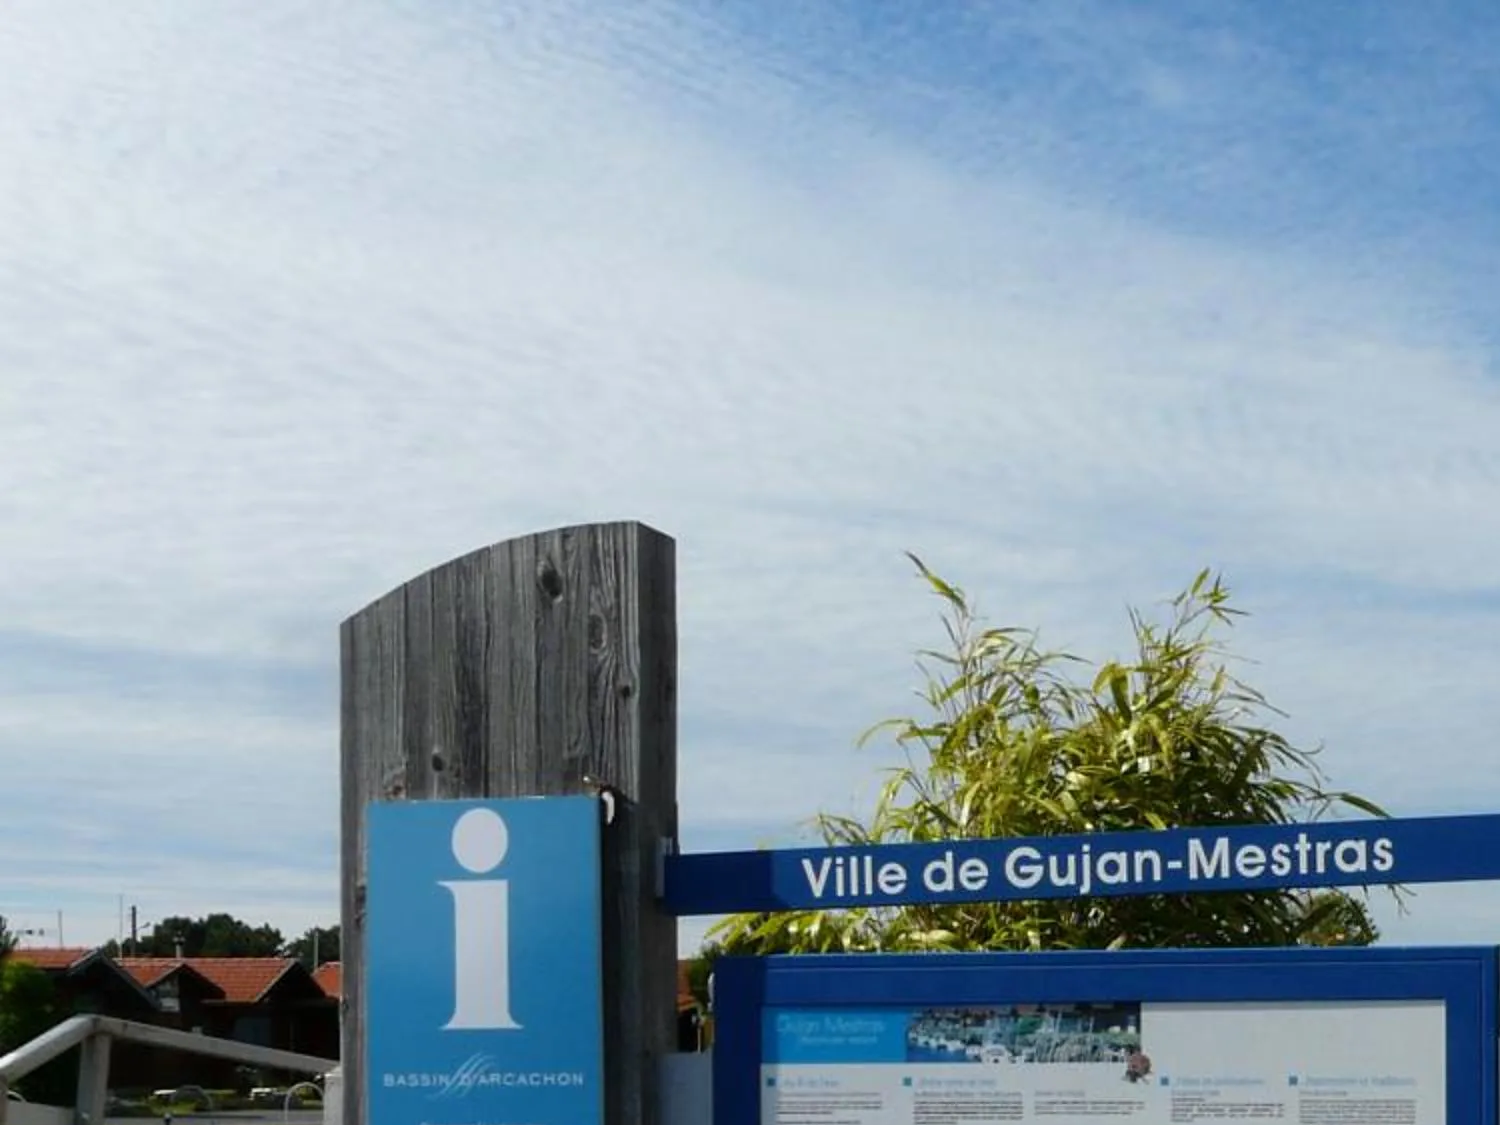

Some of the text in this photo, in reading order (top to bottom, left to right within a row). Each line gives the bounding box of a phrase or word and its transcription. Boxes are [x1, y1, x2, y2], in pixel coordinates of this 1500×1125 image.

[802, 834, 1395, 898] Ville de Gujan-Mestras
[383, 1072, 450, 1088] BASSIN
